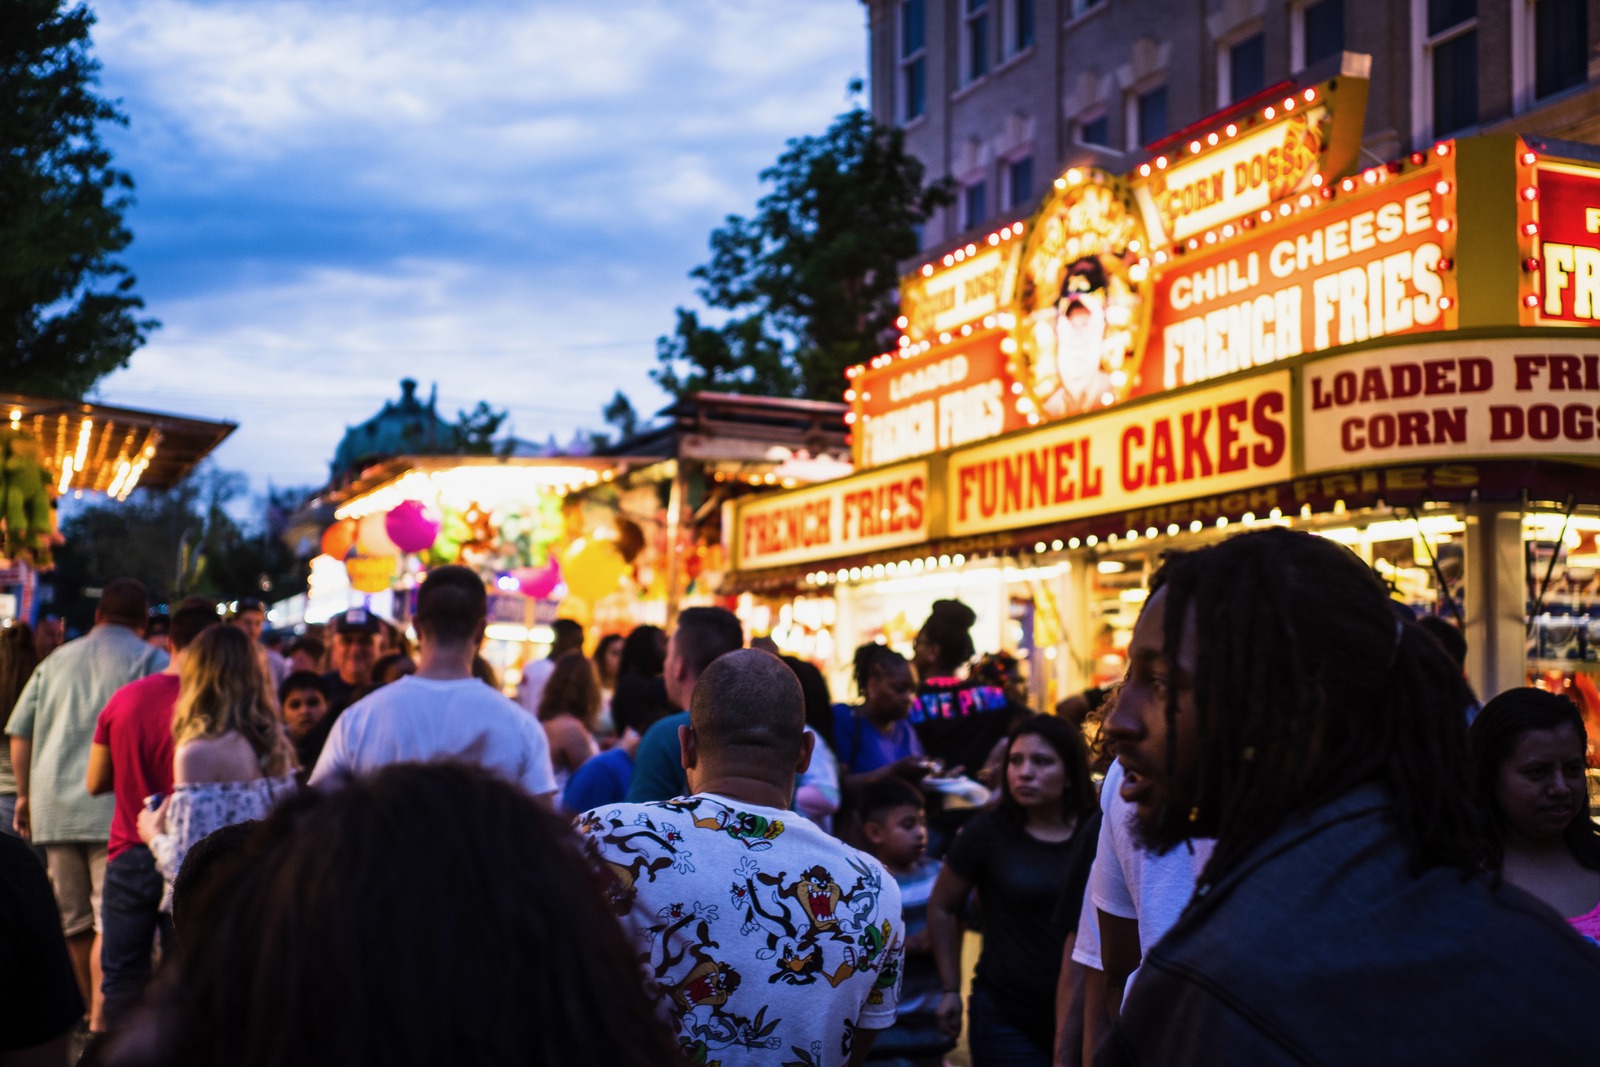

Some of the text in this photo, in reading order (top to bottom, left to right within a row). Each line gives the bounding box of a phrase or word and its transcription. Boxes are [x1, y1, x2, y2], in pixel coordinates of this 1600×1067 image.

[1167, 169, 1225, 221] CORN
[1169, 190, 1433, 311] CHILI CHEESE
[1163, 242, 1445, 390] FRENCH FRIES
[1311, 356, 1494, 411] LOADED
[957, 390, 1286, 522] FUNNEL CAKES
[1340, 402, 1600, 452] CORN DOG
[743, 475, 925, 558] FRENCH FRIES
[1124, 465, 1481, 529] FRENCH FRIES
